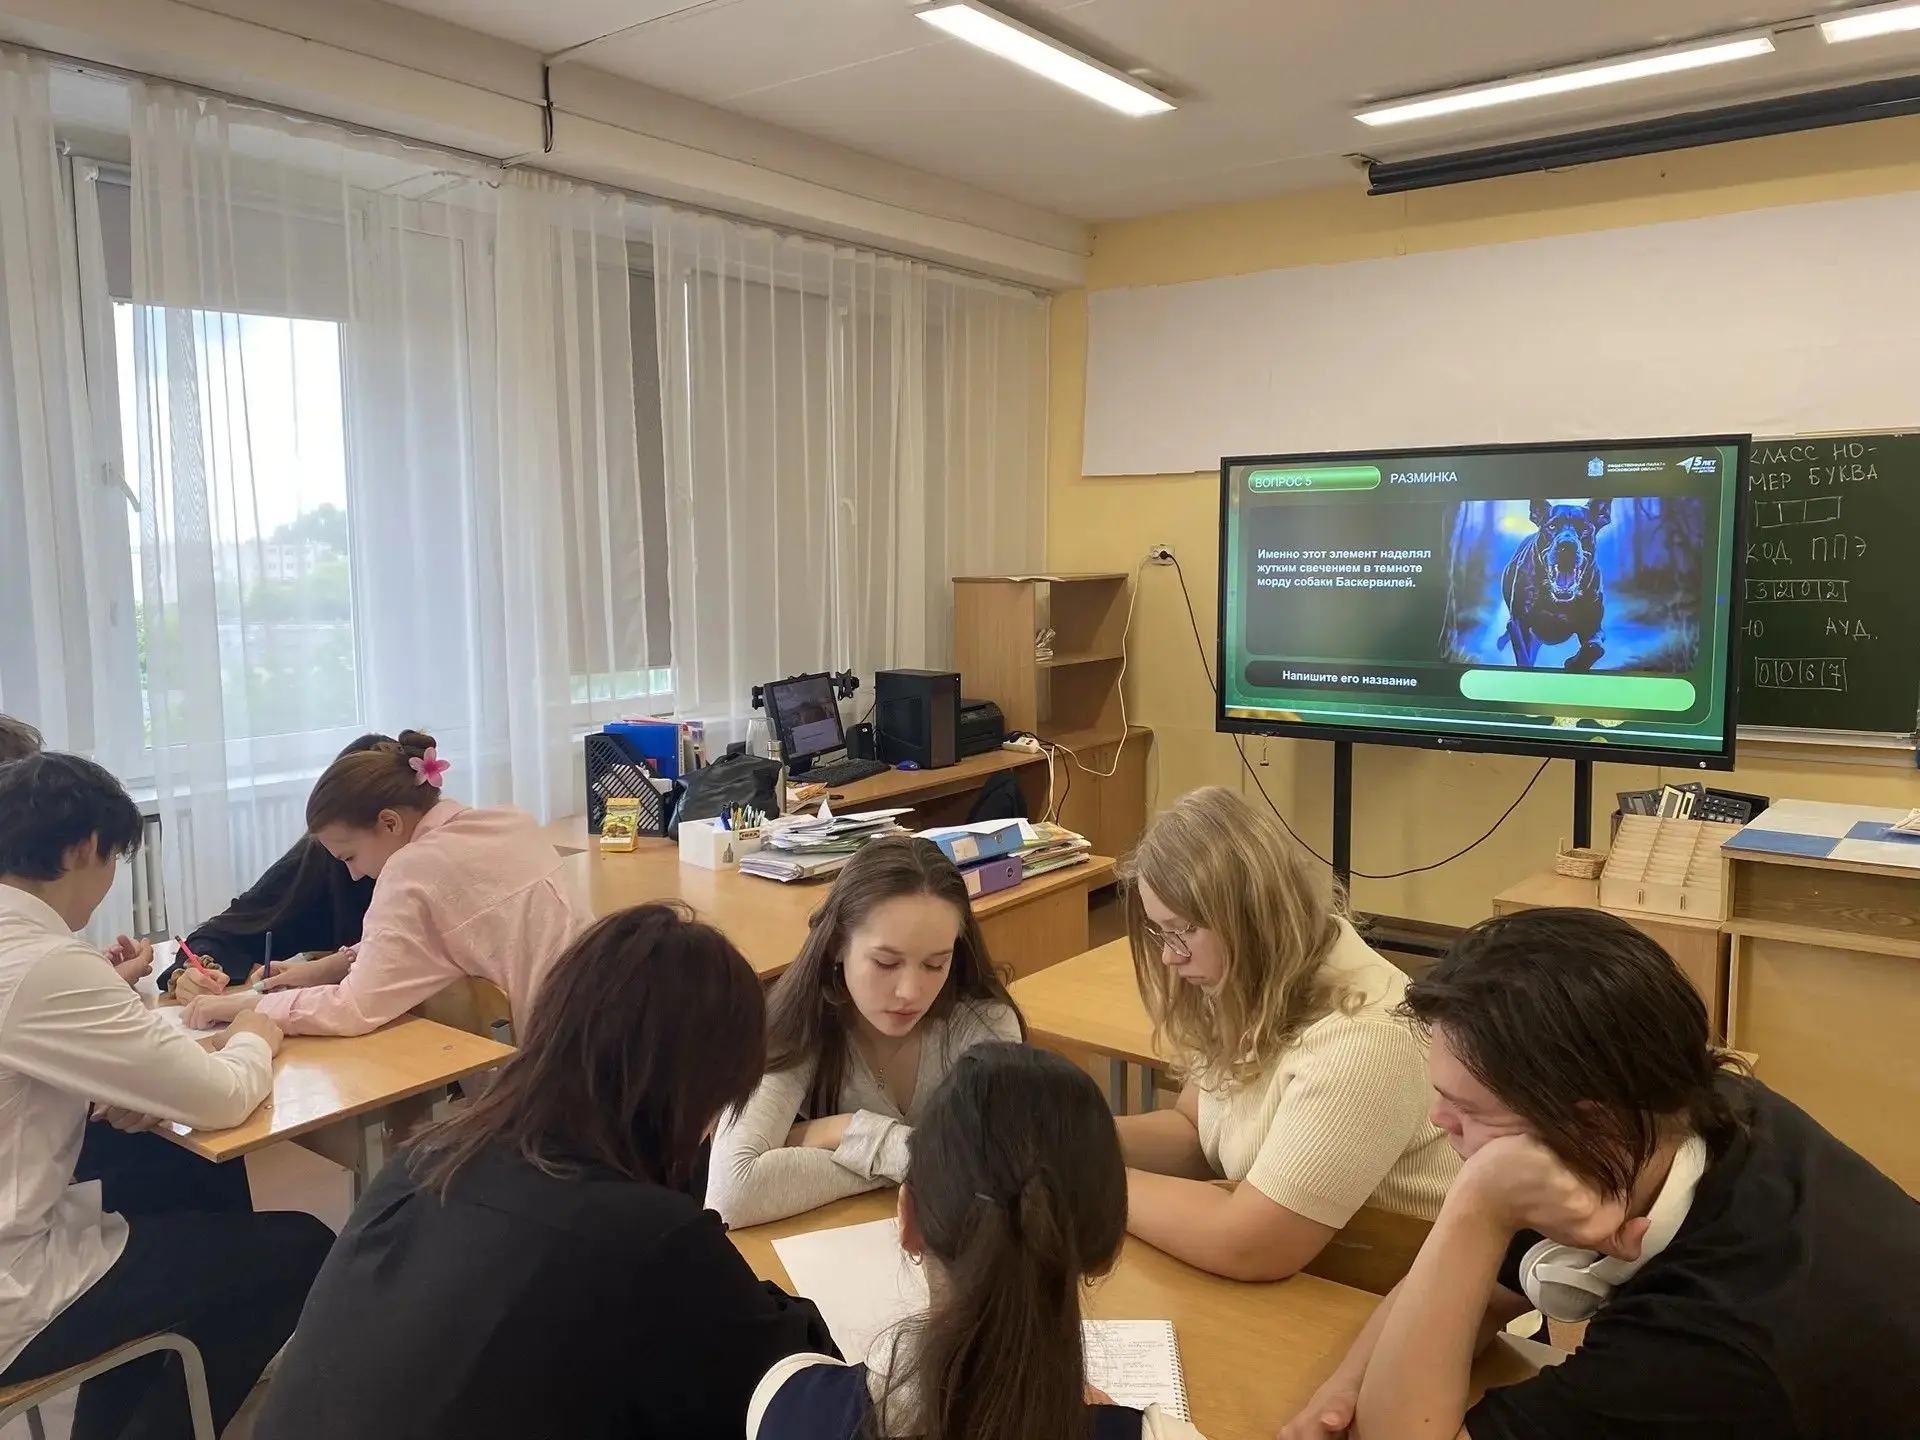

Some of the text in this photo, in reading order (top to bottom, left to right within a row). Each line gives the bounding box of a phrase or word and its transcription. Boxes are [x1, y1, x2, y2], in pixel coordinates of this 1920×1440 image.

[1254, 475, 1313, 489] ВОПРОС 5
[1389, 471, 1459, 485] РАЗМИНКА
[1748, 464, 1879, 492] МЕР БУКВА
[1257, 548, 1431, 560] Именно этот элемент наделял
[1745, 533, 1867, 565] КОД ППЭ
[1256, 563, 1423, 575] жутким свечением в темноте
[1256, 576, 1416, 589] морду собаки Баскервилей.
[1825, 617, 1878, 641] АУД.
[1282, 669, 1418, 687] Напишите его название
